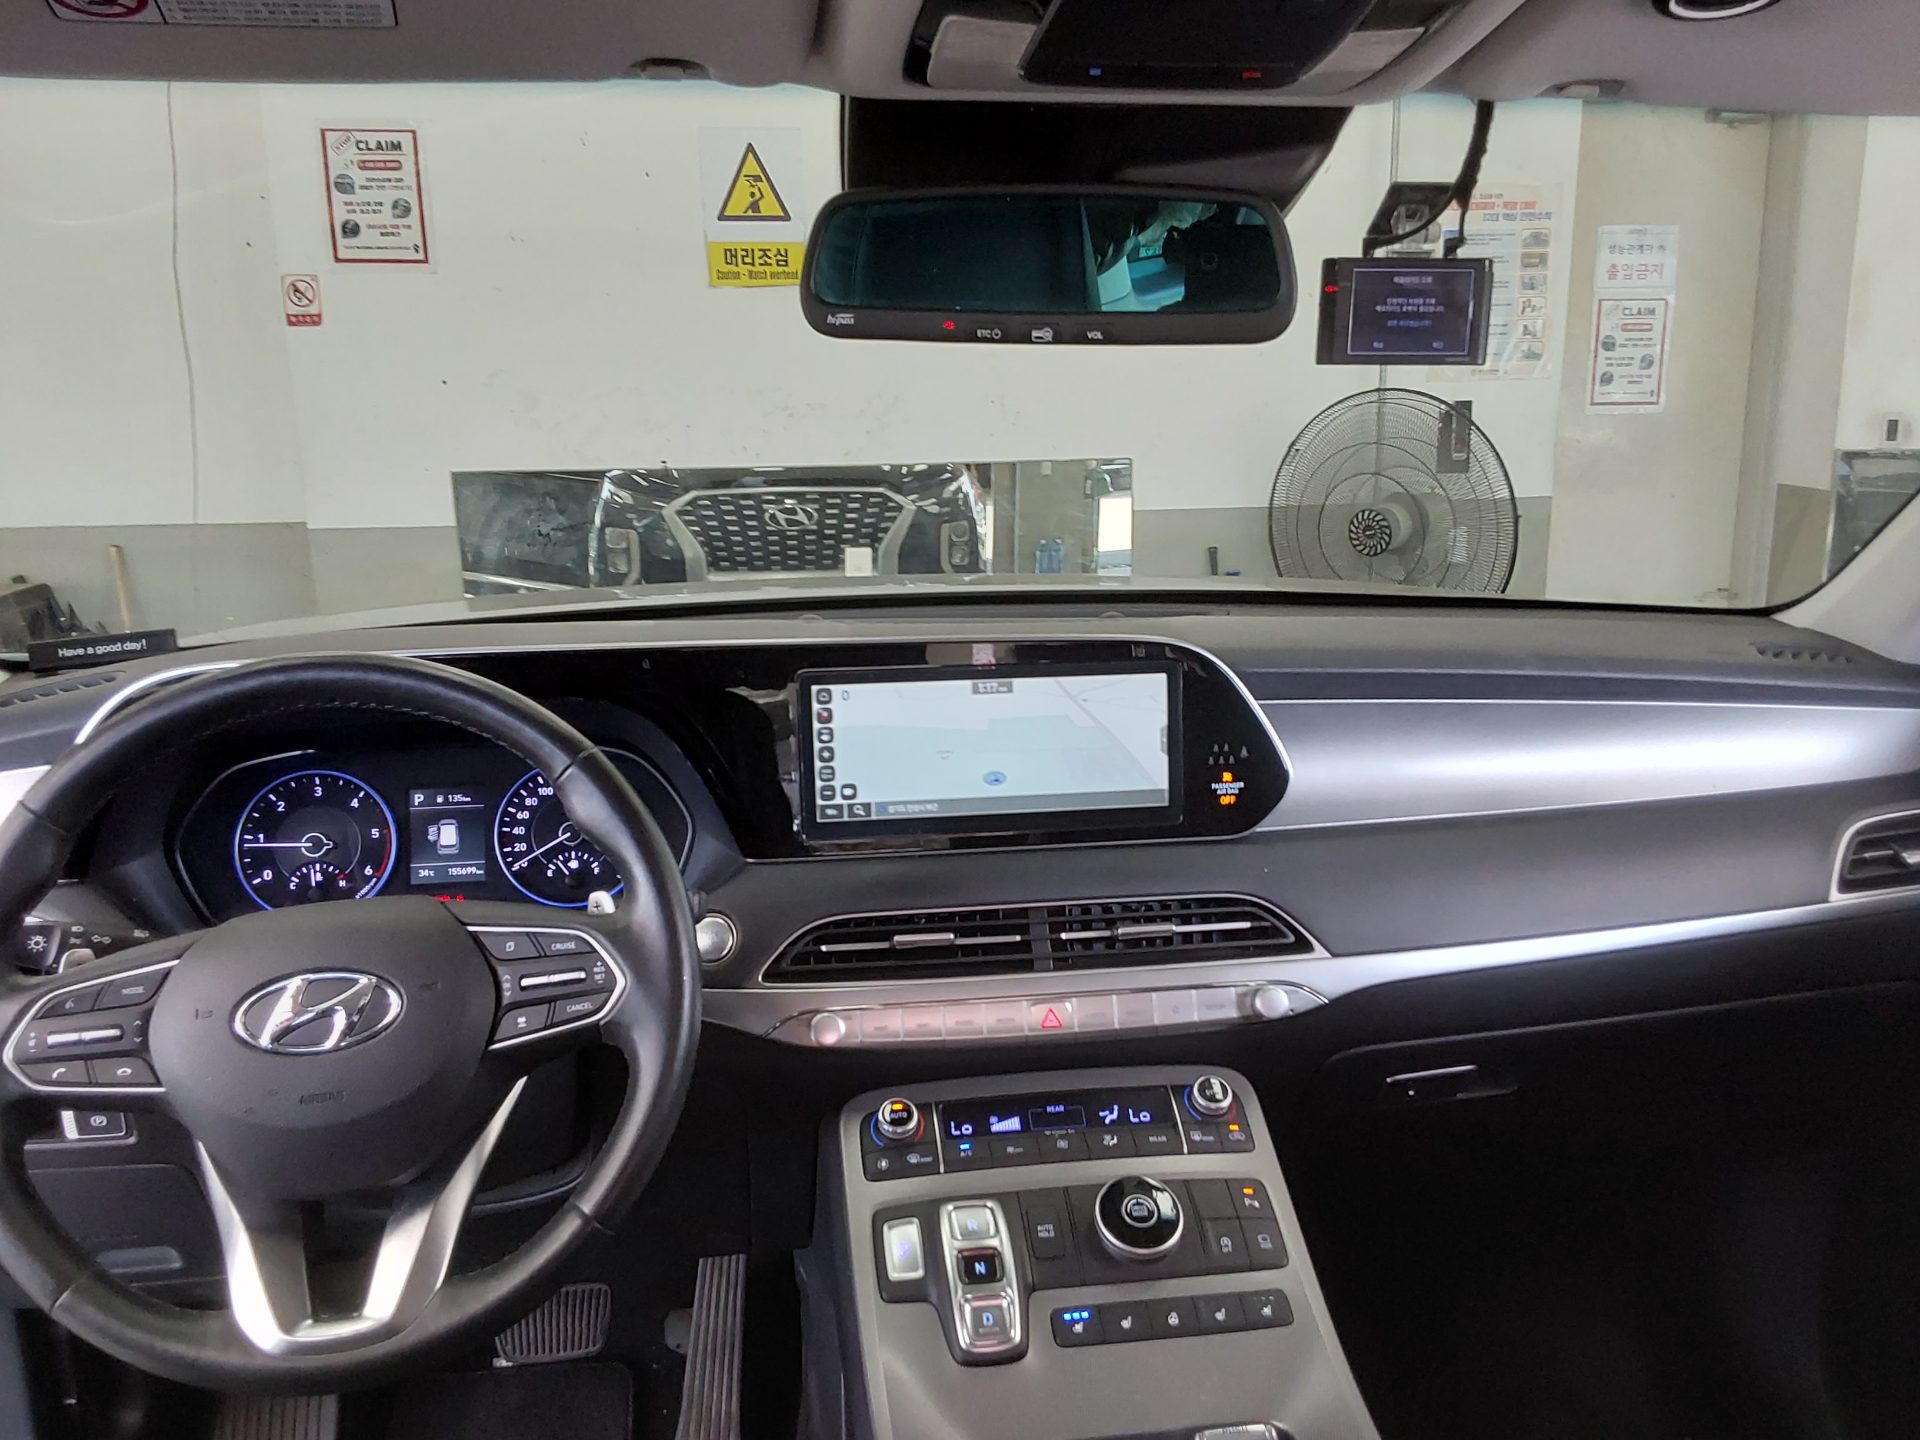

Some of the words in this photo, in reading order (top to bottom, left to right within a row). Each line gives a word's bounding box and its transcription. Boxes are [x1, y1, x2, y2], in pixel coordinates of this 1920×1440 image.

[355, 139, 403, 152] CLAIM
[724, 248, 789, 267] 머리조심
[1606, 263, 1664, 281] 출입금지
[1622, 307, 1657, 317] CLAIM
[977, 328, 991, 339] ETC
[1087, 330, 1103, 340] VOL
[58, 647, 85, 658] Have
[95, 642, 122, 655] good
[123, 638, 147, 651] day!
[1212, 781, 1245, 790] PASSENGER
[314, 787, 322, 797] 3
[538, 787, 554, 796] 100
[350, 798, 359, 808] 4
[414, 794, 424, 806] P
[525, 797, 538, 806] 80
[1220, 795, 1237, 806] OFF
[277, 802, 285, 811] 2
[516, 810, 529, 819] 60
[371, 829, 380, 838] 5
[512, 826, 525, 835] 40
[514, 843, 526, 851] 20
[263, 870, 272, 880] 0
[364, 867, 373, 876] 6
[547, 868, 553, 876] E
[551, 941, 576, 950] CRUISE
[566, 1002, 593, 1012] CANCEL
[890, 1111, 908, 1119] AUTO
[1128, 1108, 1151, 1123] Lo
[950, 1121, 973, 1136] Lo
[967, 1219, 978, 1231] R
[975, 1261, 986, 1275] N
[982, 1312, 994, 1326] D
